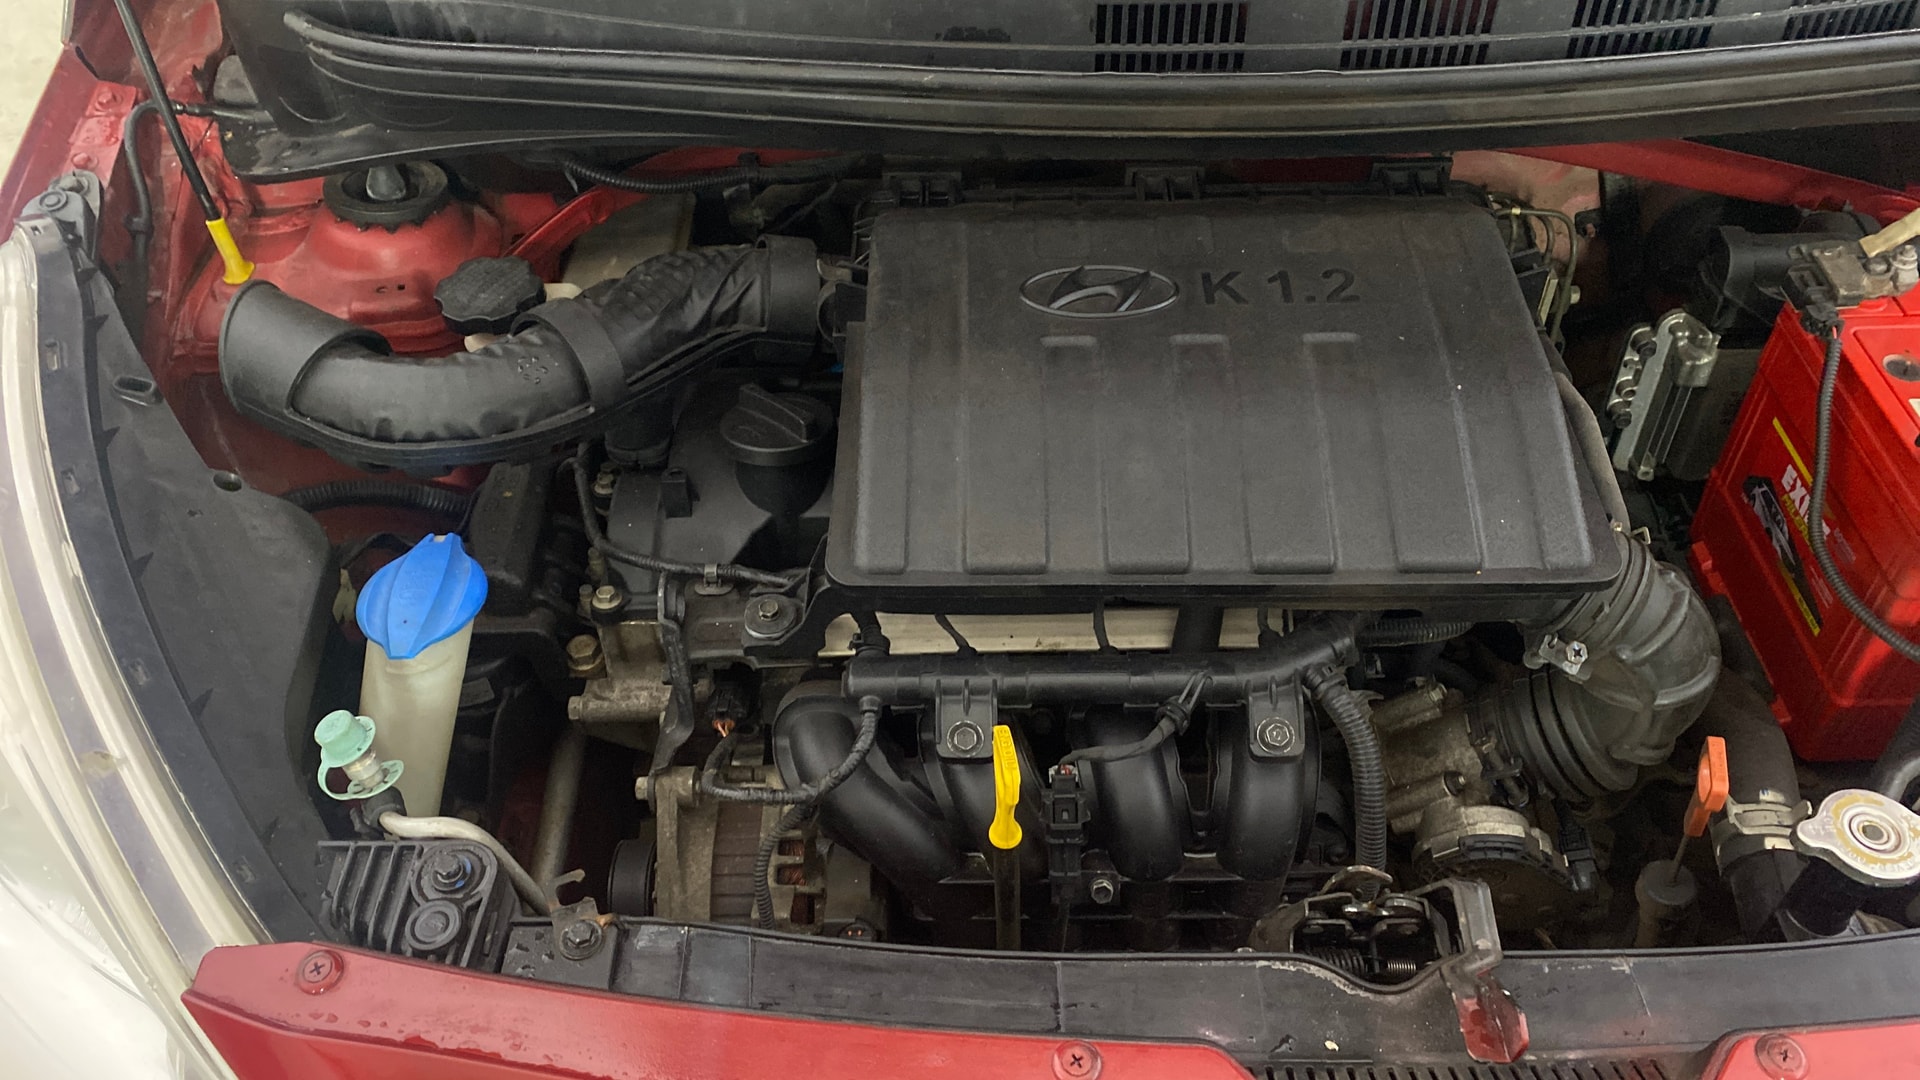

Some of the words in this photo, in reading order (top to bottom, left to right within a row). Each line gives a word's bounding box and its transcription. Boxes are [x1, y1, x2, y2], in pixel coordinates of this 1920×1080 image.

[1201, 270, 1249, 305] K
[1267, 267, 1361, 304] 1.2
[1781, 464, 1831, 540] EXI
